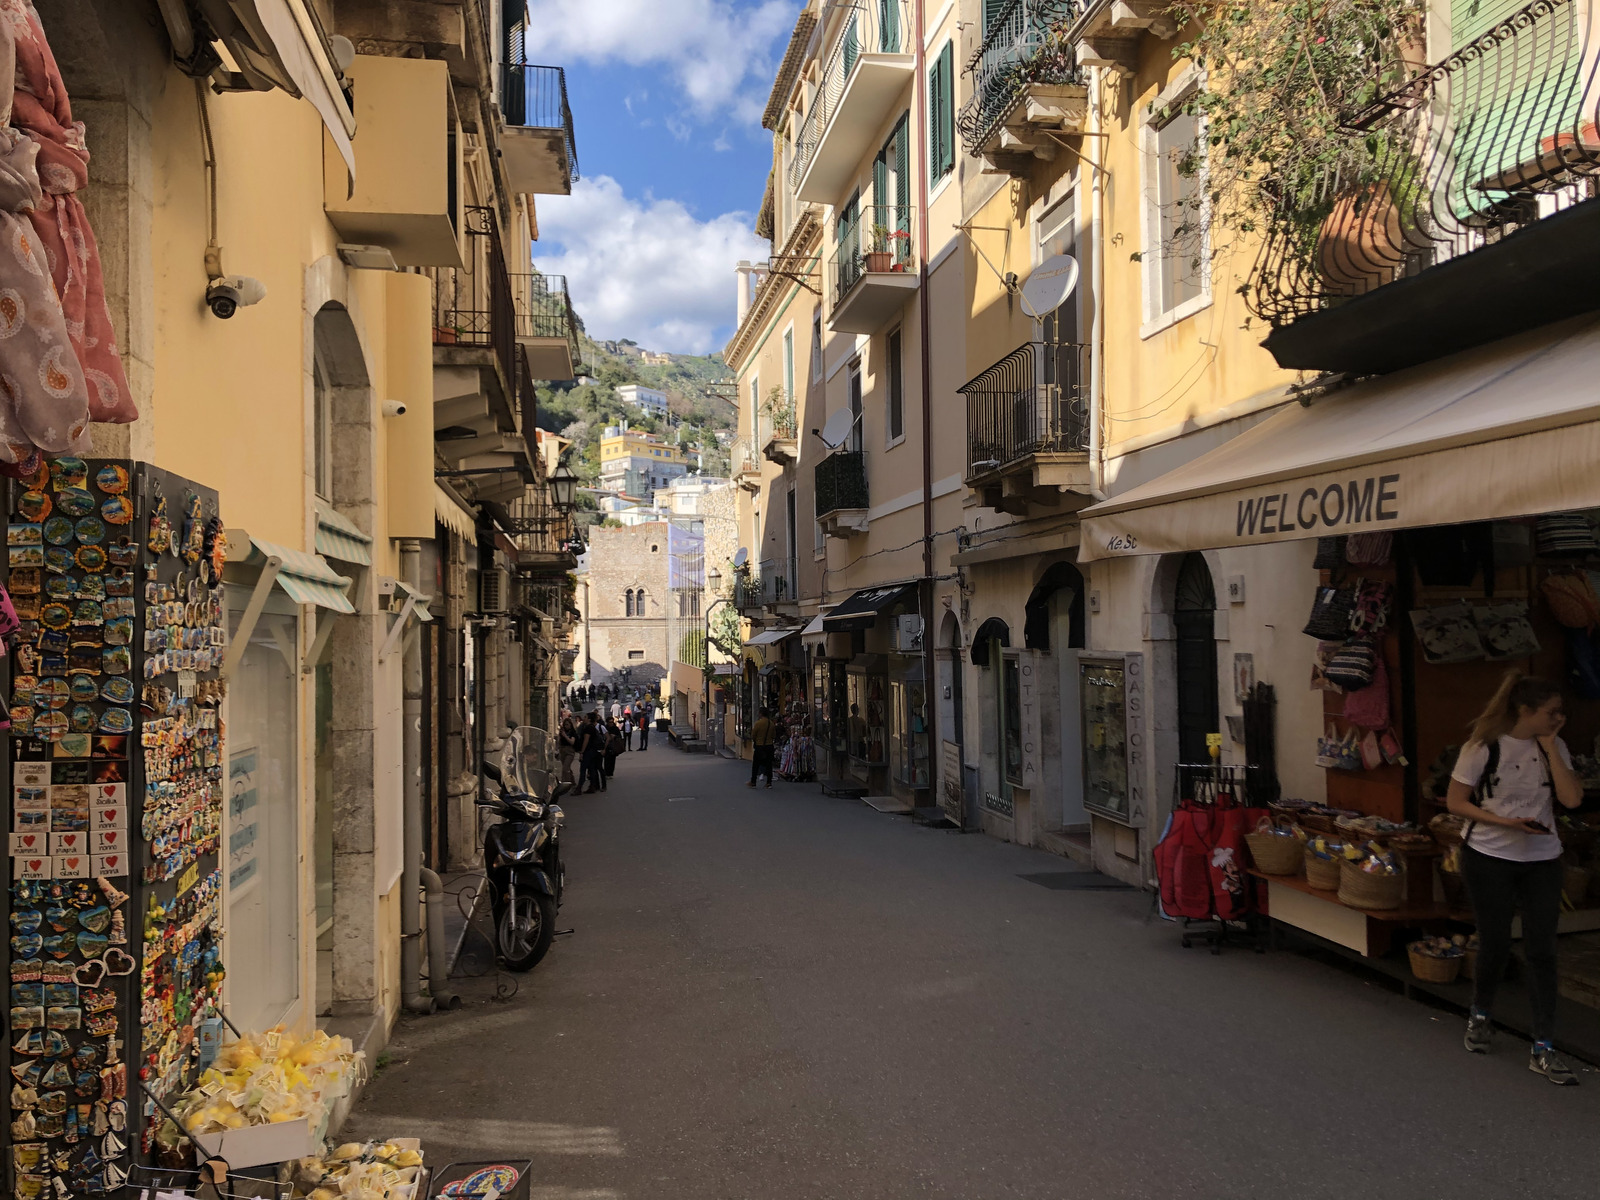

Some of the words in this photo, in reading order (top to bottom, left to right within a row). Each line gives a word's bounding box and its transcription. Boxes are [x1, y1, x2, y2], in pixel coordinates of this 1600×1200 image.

[1236, 474, 1400, 536] WELCOME
[1022, 665, 1035, 773] OTTICA
[1128, 662, 1145, 818] CASTORINA
